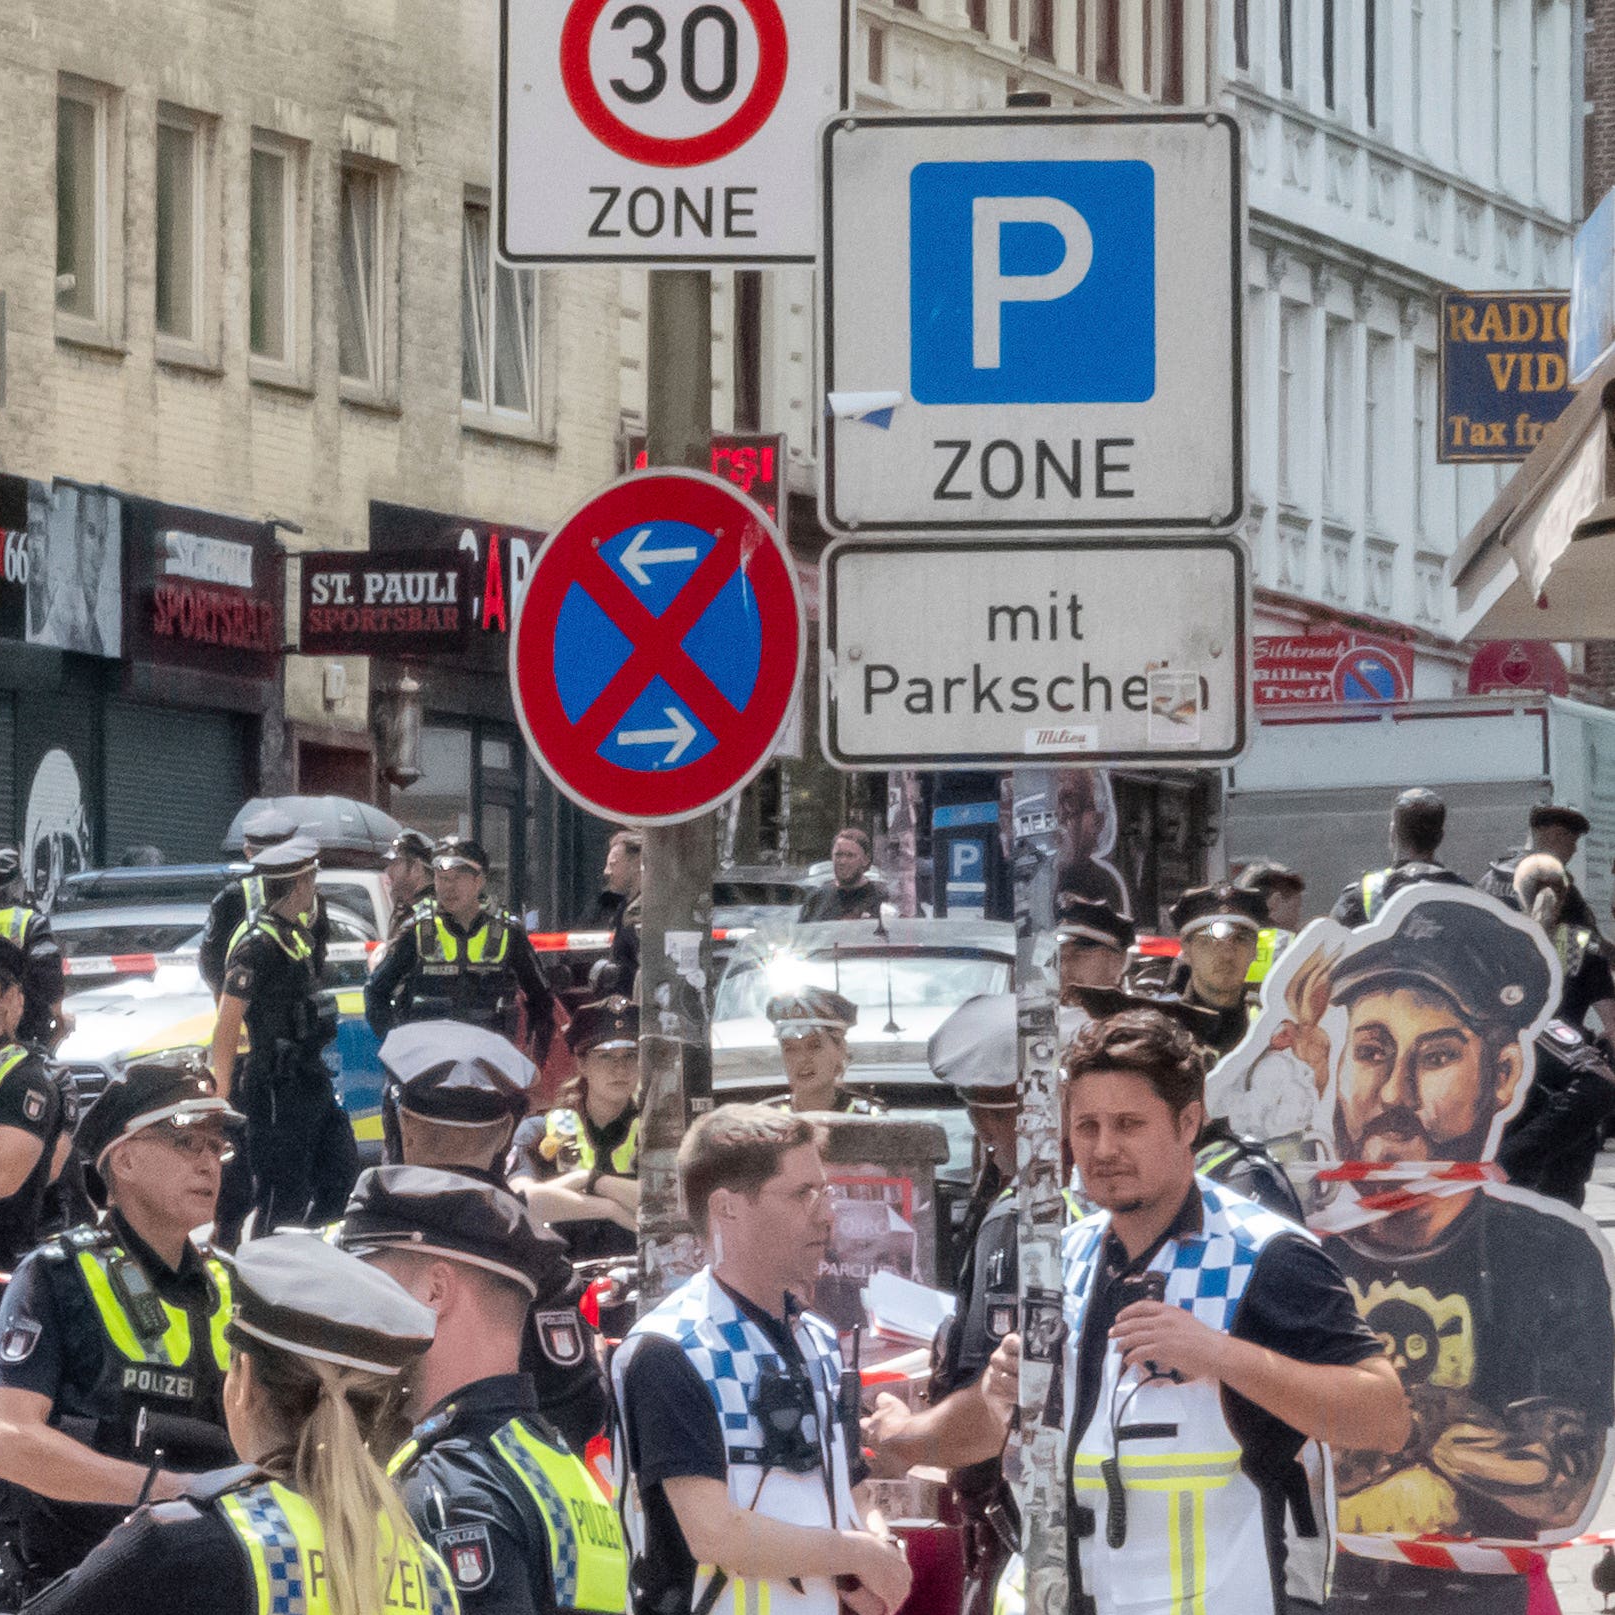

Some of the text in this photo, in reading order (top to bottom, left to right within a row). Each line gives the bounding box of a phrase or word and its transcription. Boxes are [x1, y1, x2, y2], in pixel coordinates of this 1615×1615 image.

[609, 3, 738, 104] 30
[587, 186, 759, 239] ZONE
[971, 195, 1093, 370] P
[1486, 353, 1568, 392] VID
[1448, 416, 1508, 447] Tax
[931, 438, 1135, 501] ZONE
[311, 571, 458, 604] ST. PAULI
[308, 606, 459, 632] SPORTSBAR
[987, 589, 1084, 641] mit
[953, 843, 980, 878] P
[123, 1368, 194, 1398] POLIZEI
[570, 1497, 622, 1551] POLIZEI
[307, 1549, 426, 1611] PZEI
